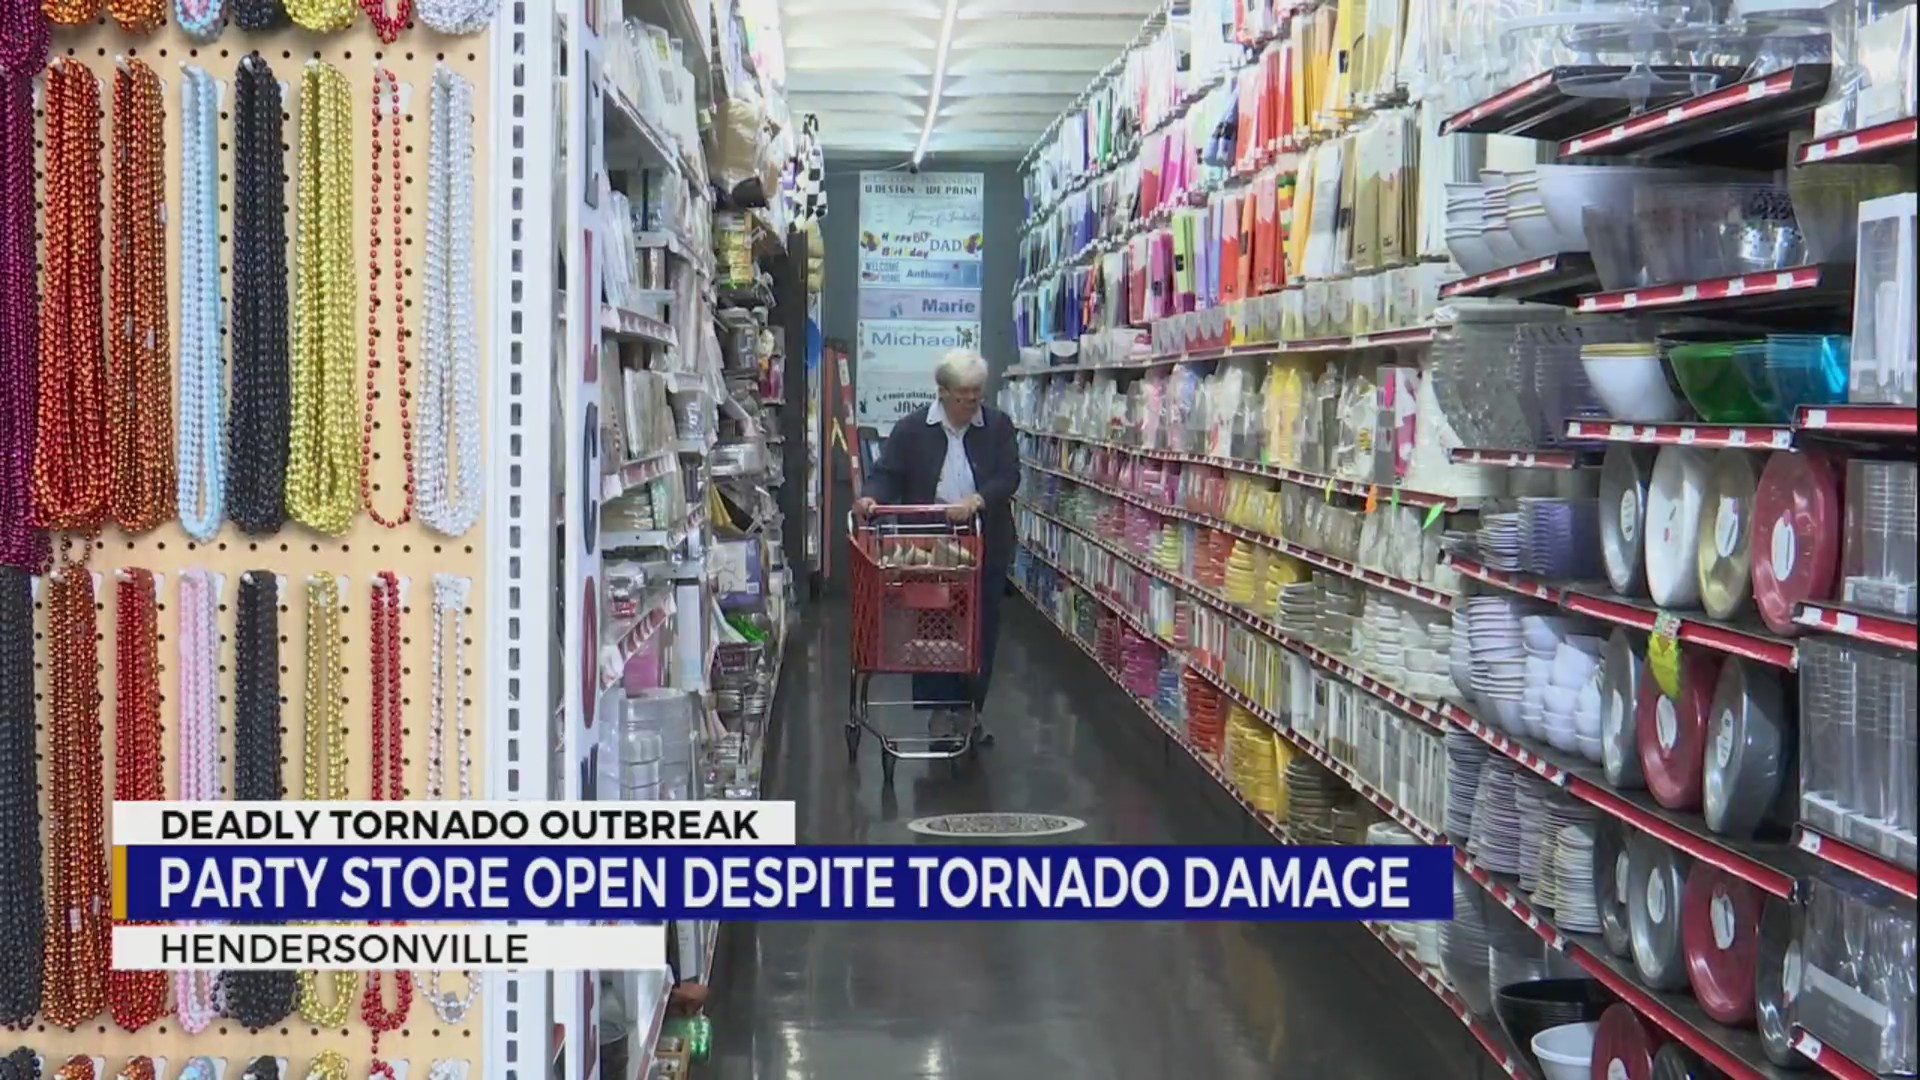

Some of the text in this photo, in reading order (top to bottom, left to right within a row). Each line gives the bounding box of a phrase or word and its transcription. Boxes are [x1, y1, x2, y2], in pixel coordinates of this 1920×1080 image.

[875, 184, 915, 194] DESIGN
[926, 186, 940, 194] WE
[945, 186, 977, 195] PRINT
[929, 239, 962, 251] DAD
[905, 269, 950, 280] Anthony
[921, 298, 976, 313] Marie
[871, 332, 961, 346] Michael
